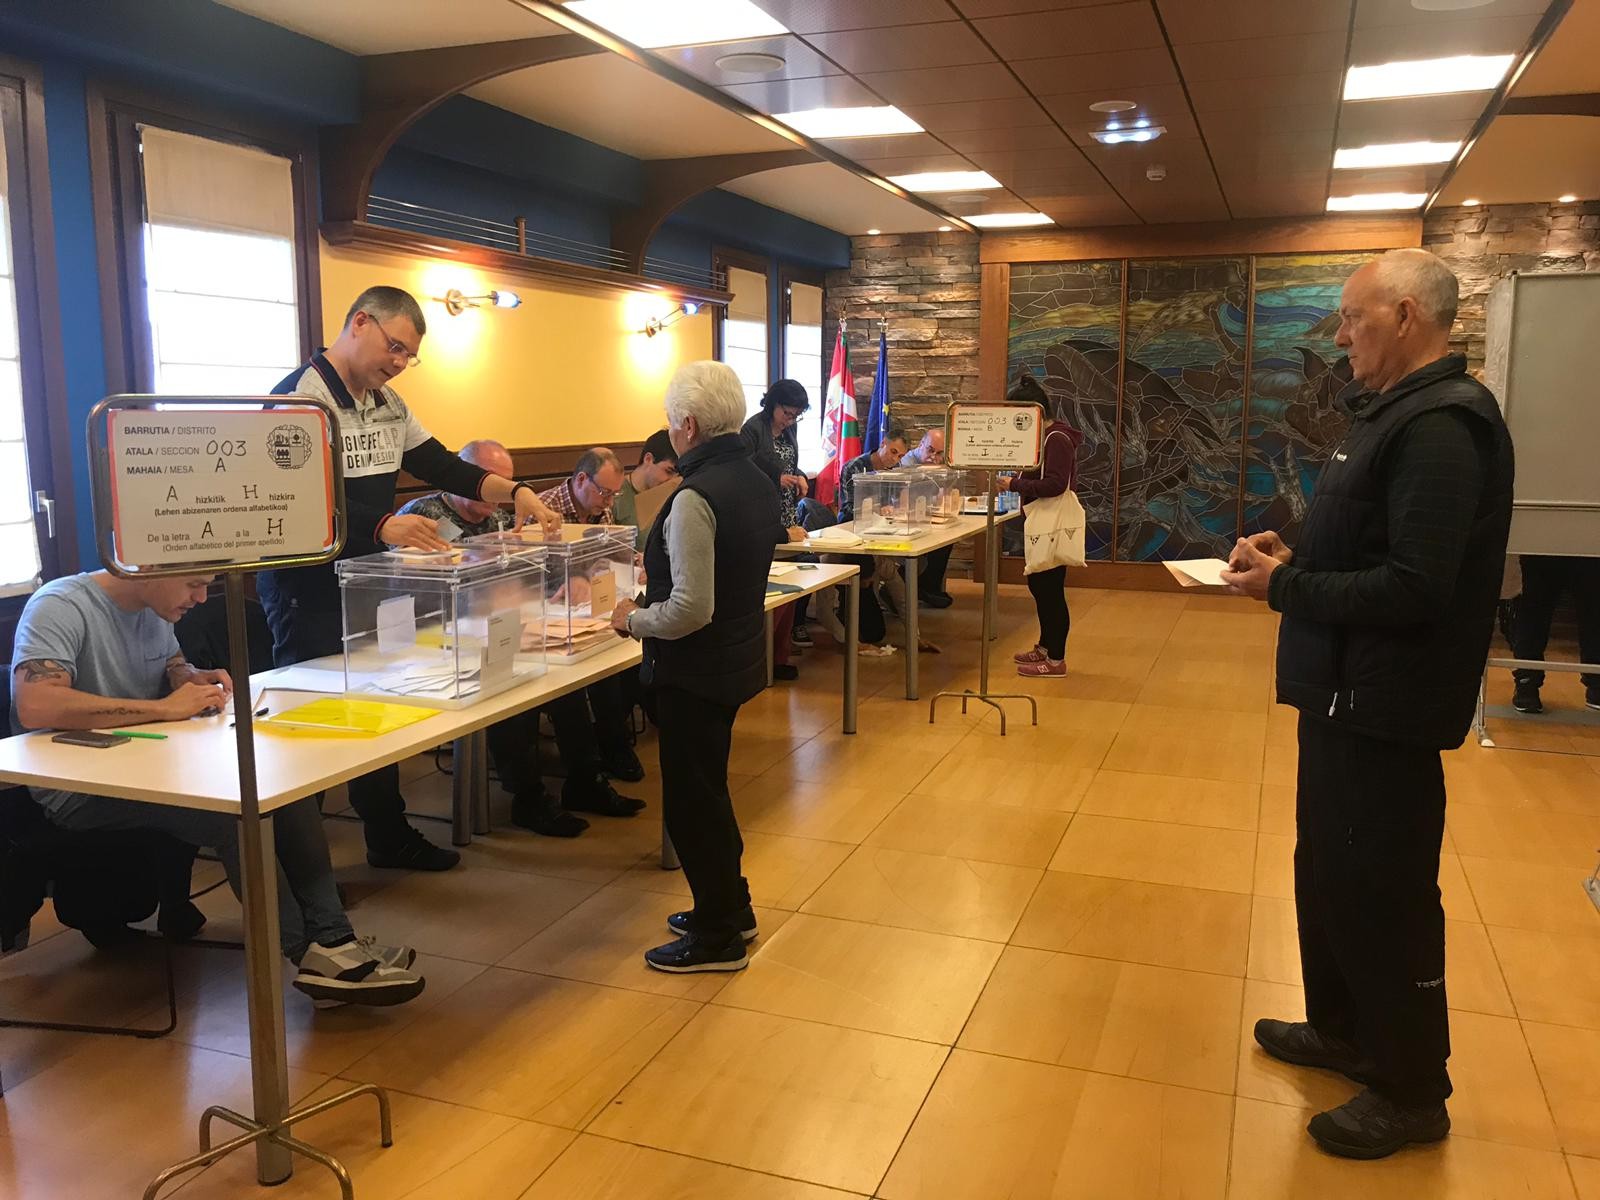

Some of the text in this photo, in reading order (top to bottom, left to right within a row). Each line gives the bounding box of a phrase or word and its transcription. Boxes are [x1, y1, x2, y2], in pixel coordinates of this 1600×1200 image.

[124, 426, 170, 435] BARRUTIA
[177, 426, 216, 435] DISTRITO
[125, 447, 154, 456] ATALA
[161, 447, 200, 455] SECCION
[206, 440, 247, 457] 003
[126, 466, 162, 475] MAHAIA
[169, 465, 194, 474] MESA
[215, 457, 226, 473] A
[166, 484, 295, 504] A hizkitik H hizkira
[154, 503, 288, 518] (Lehen abizenaren ordena alfabetikoa)
[147, 518, 283, 543] De la letra A a la H
[162, 544, 187, 552] (Orden
[223, 540, 234, 548] del
[235, 540, 256, 549] primer
[258, 537, 285, 546] apellido)
